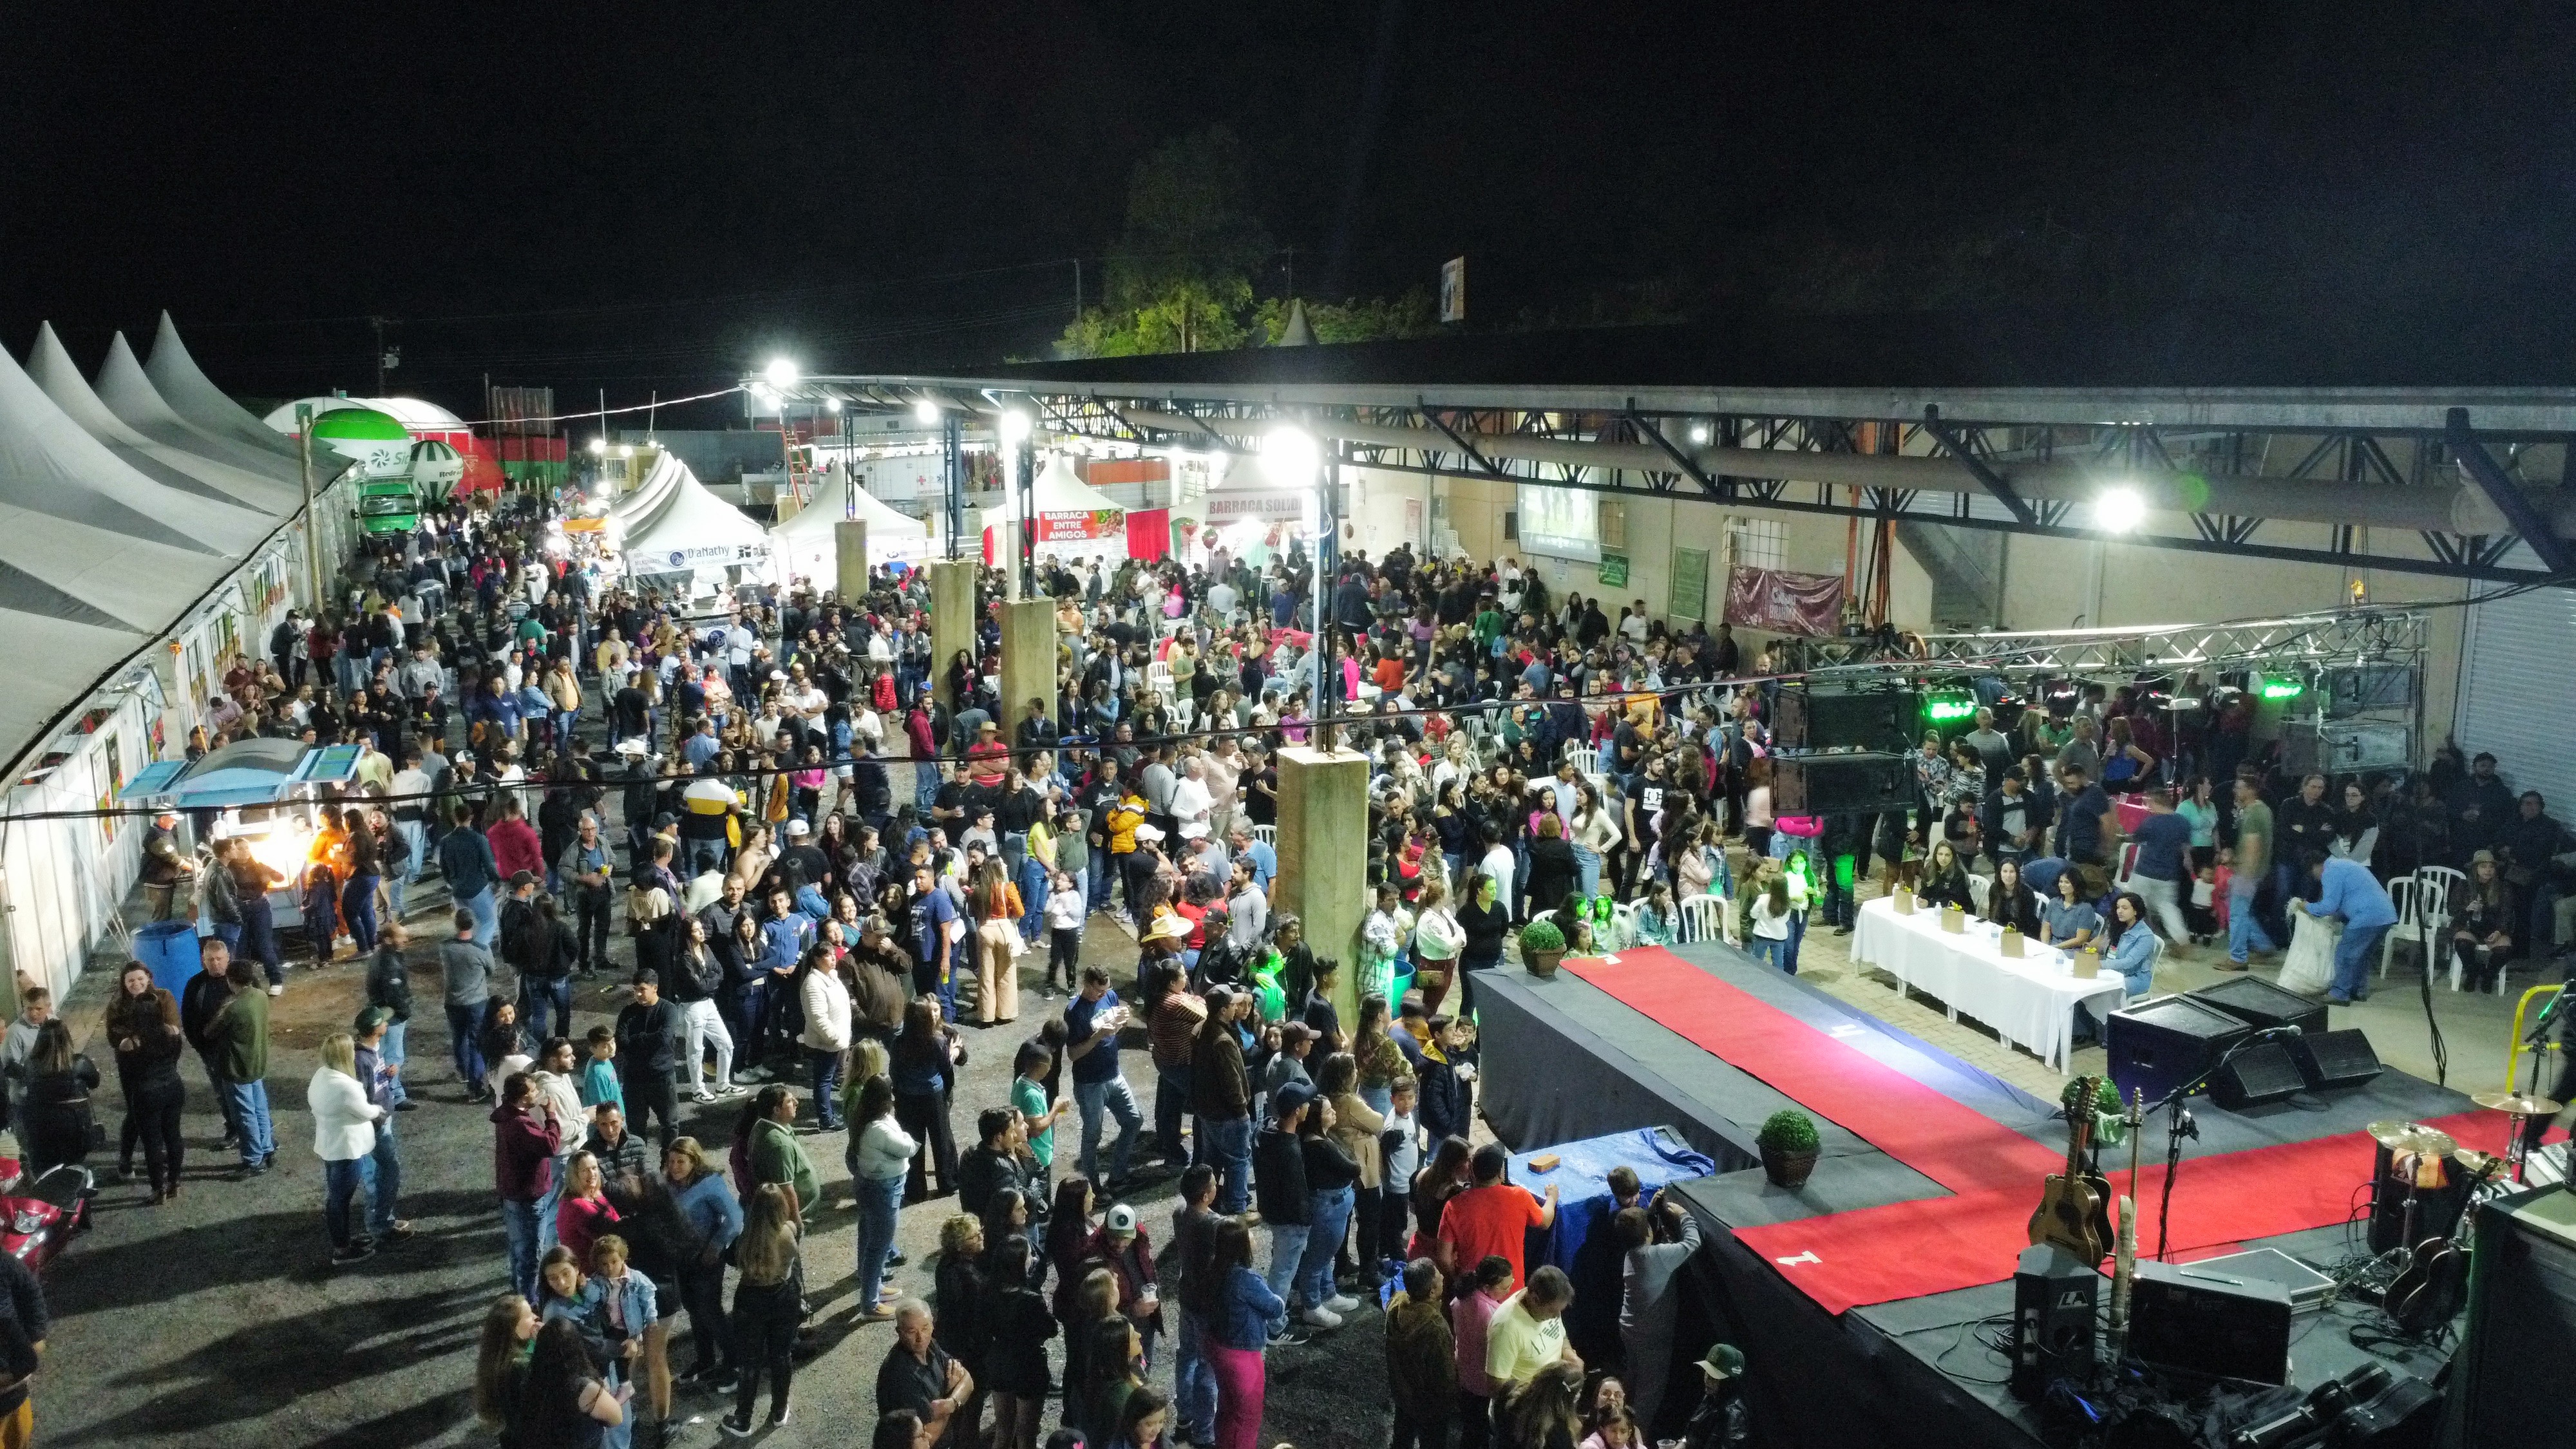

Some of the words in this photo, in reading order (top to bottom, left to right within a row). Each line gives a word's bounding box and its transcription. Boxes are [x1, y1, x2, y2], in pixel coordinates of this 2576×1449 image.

[1209, 500, 1264, 515] BARRACA
[1045, 511, 1090, 520] BARRACA
[1053, 520, 1082, 530] ENTRE
[1048, 530, 1087, 540] AMIGOS
[2058, 1290, 2089, 1309] LA
